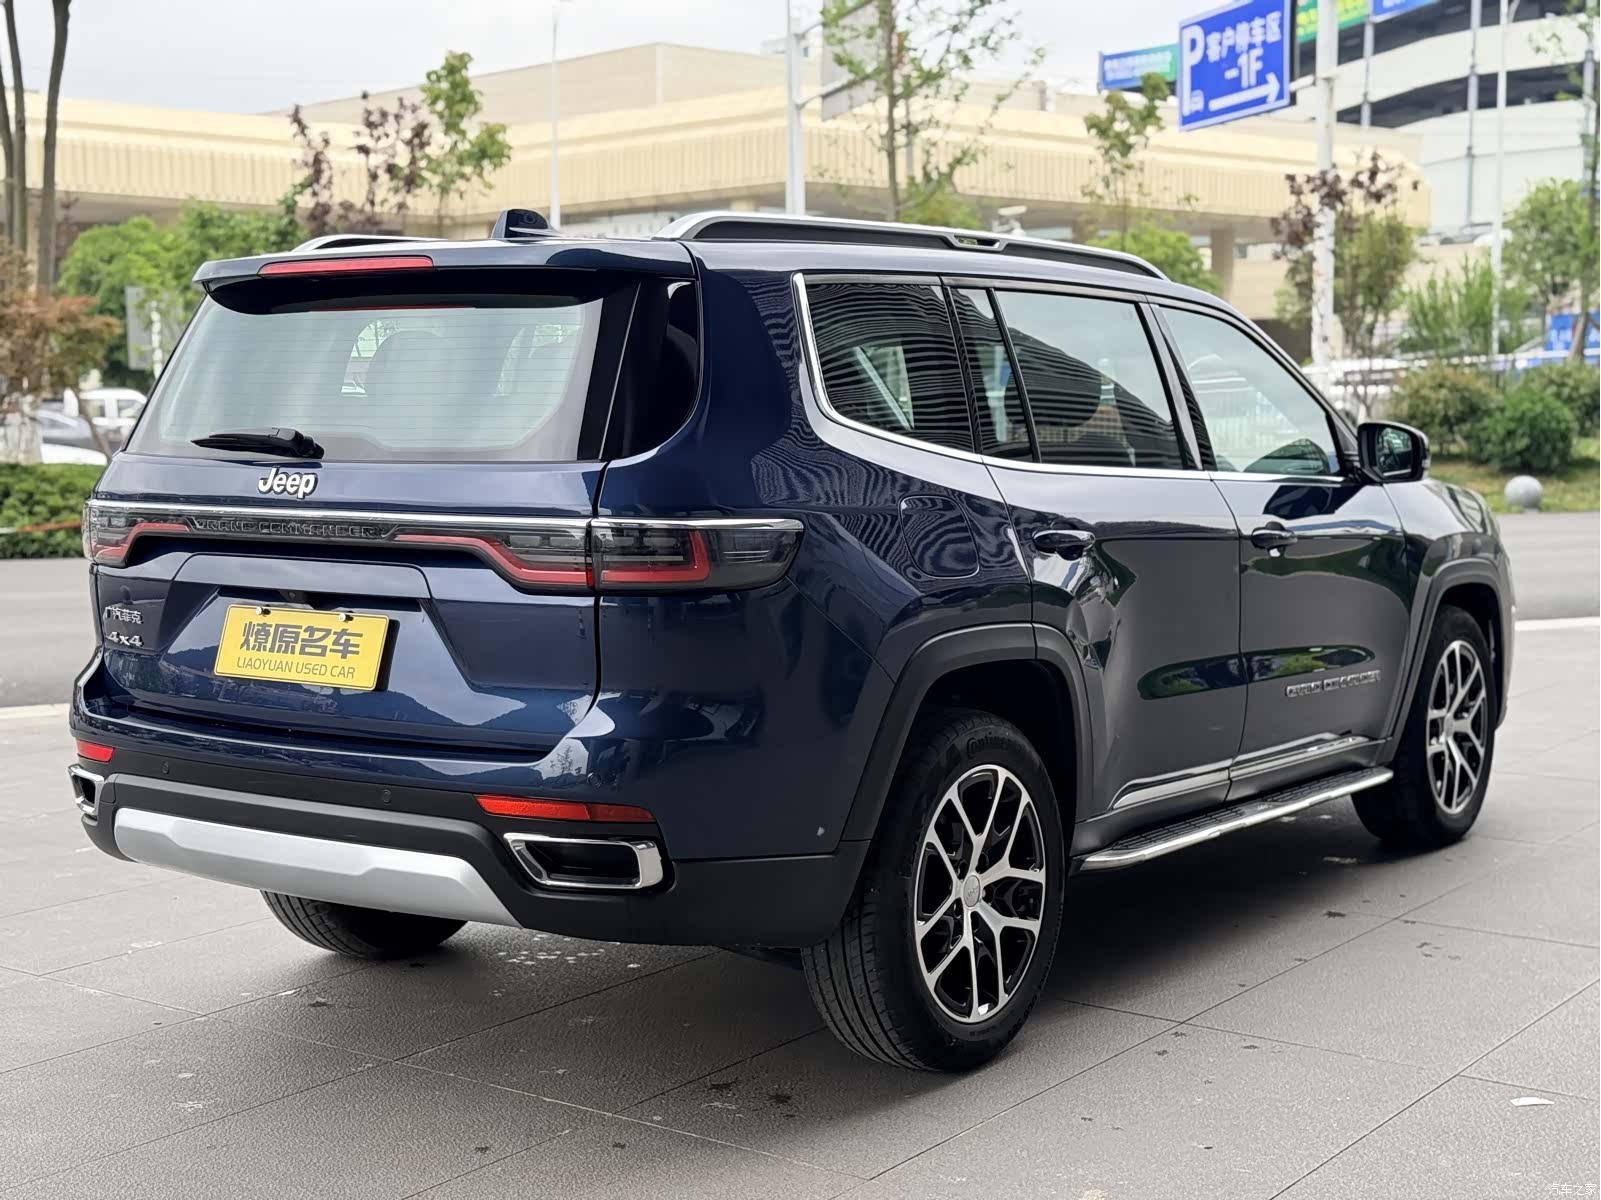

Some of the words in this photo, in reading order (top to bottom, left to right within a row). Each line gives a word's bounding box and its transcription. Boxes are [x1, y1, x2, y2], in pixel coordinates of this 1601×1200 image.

[1224, 47, 1264, 89] -1F
[258, 467, 318, 499] Jeep
[240, 621, 364, 660] 燎原名车
[236, 656, 294, 674] LIAOYUAN
[295, 662, 329, 676] USED
[330, 665, 356, 680] CAR
